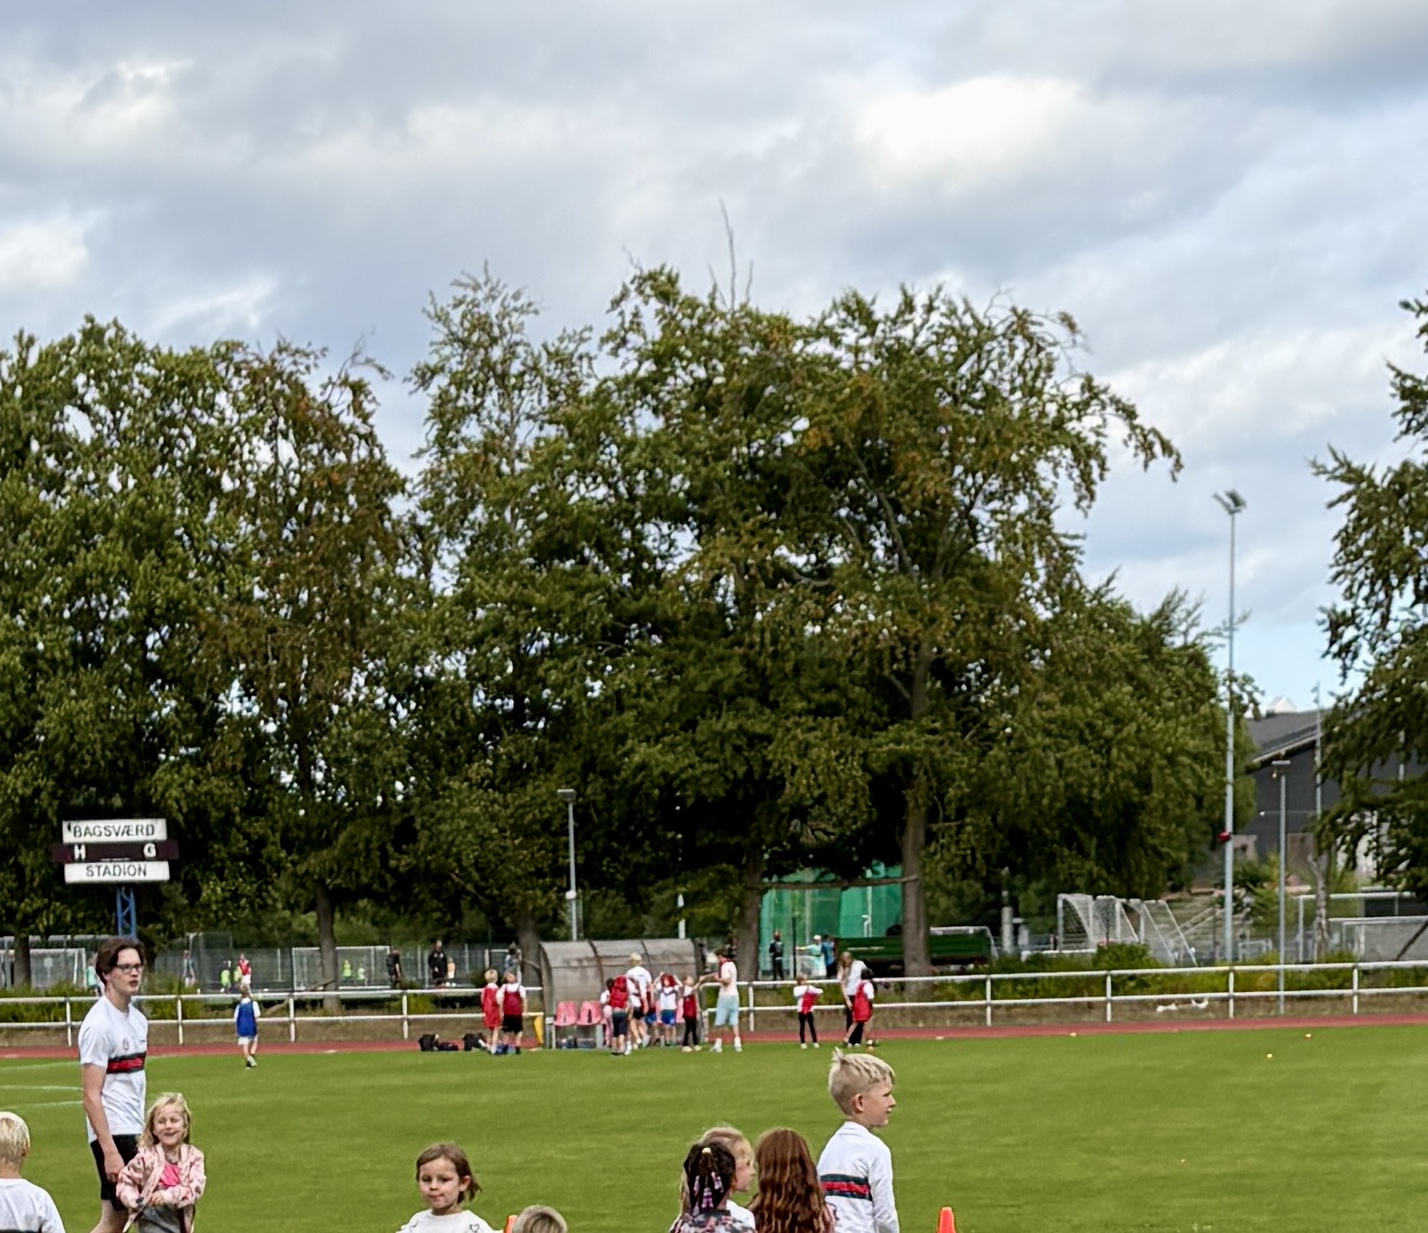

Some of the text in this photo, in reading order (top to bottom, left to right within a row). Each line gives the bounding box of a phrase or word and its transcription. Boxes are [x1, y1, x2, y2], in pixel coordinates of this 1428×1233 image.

[73, 824, 155, 838] BAGSVÆRD
[74, 843, 156, 860] H G
[86, 864, 147, 877] STADION
